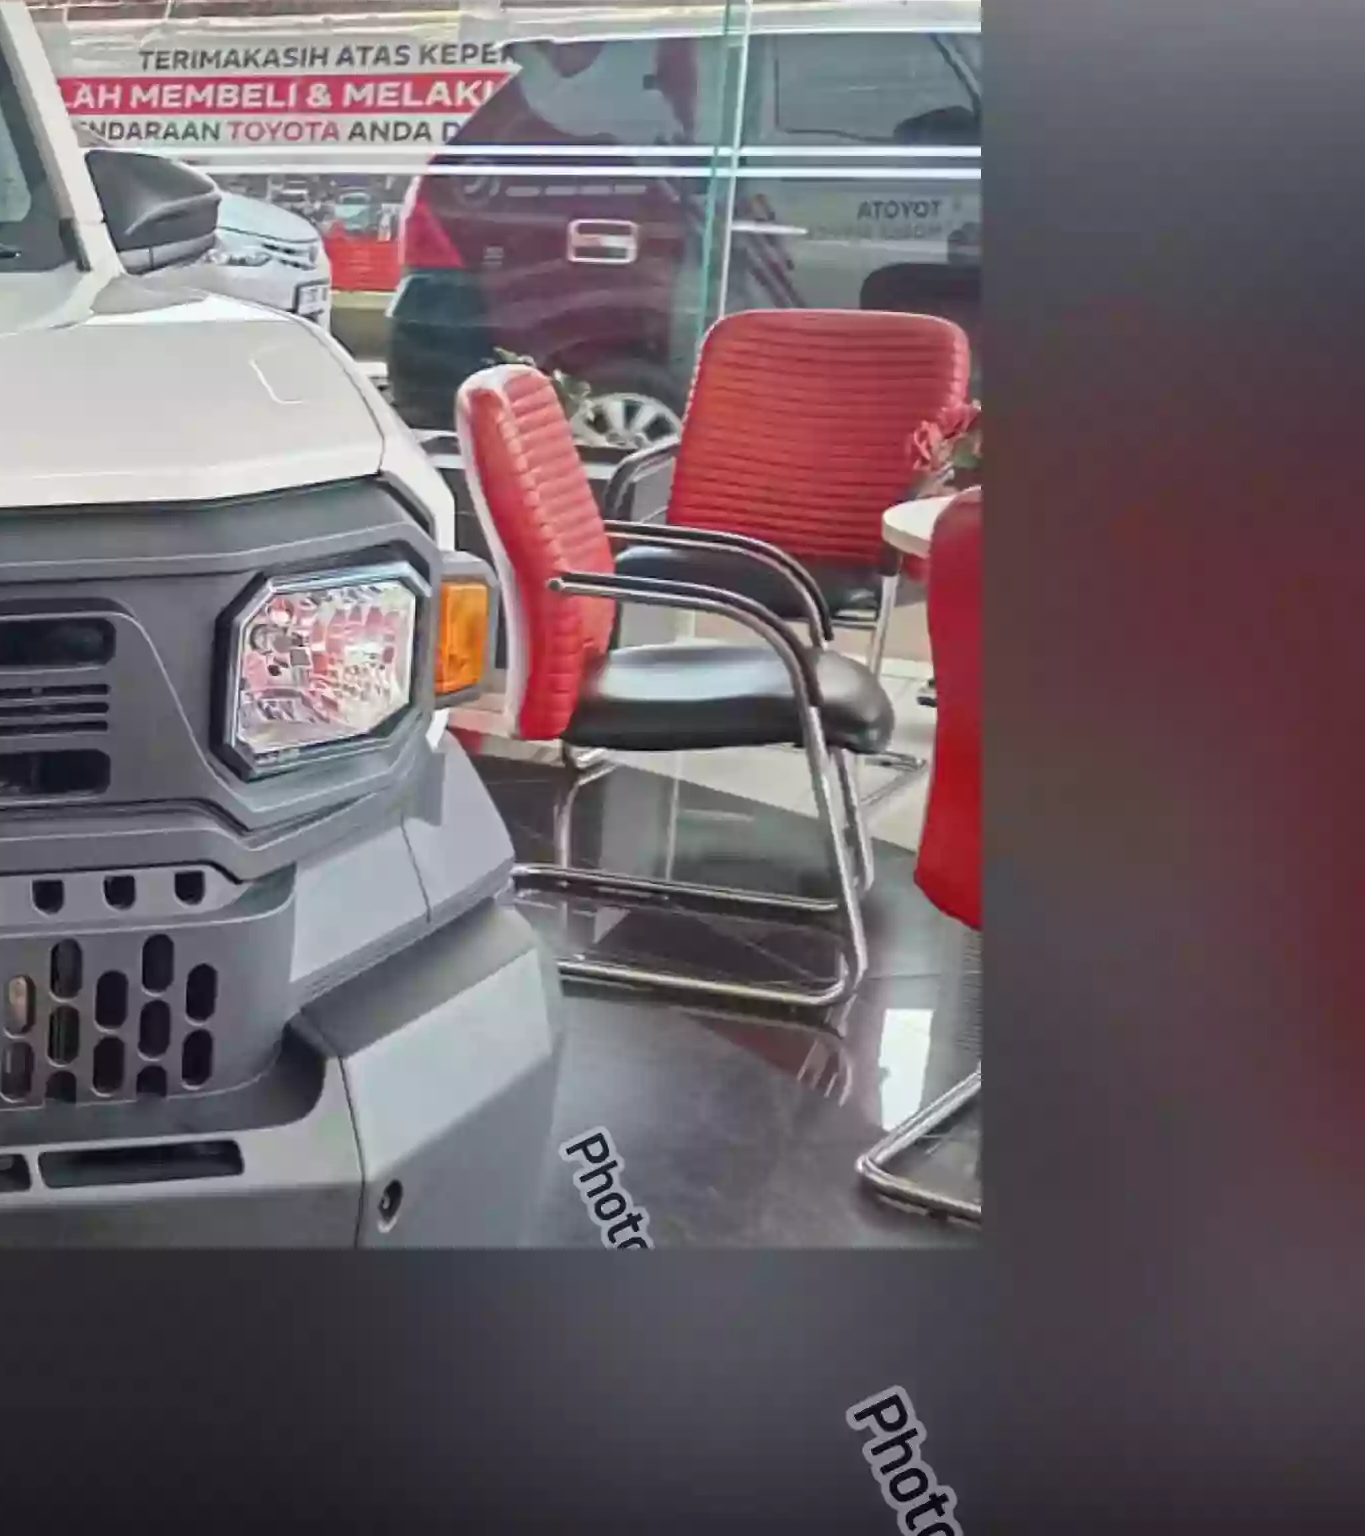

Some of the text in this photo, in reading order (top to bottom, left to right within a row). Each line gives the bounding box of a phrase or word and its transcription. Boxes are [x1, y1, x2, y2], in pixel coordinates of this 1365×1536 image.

[138, 47, 330, 71] TERIMAKASIH
[336, 44, 411, 66] ATAS
[129, 82, 297, 110] MEMBELI
[305, 82, 332, 107] &
[79, 120, 220, 141] NDARAAN
[226, 121, 340, 142] TOYOTA
[347, 120, 431, 142] ANDA
